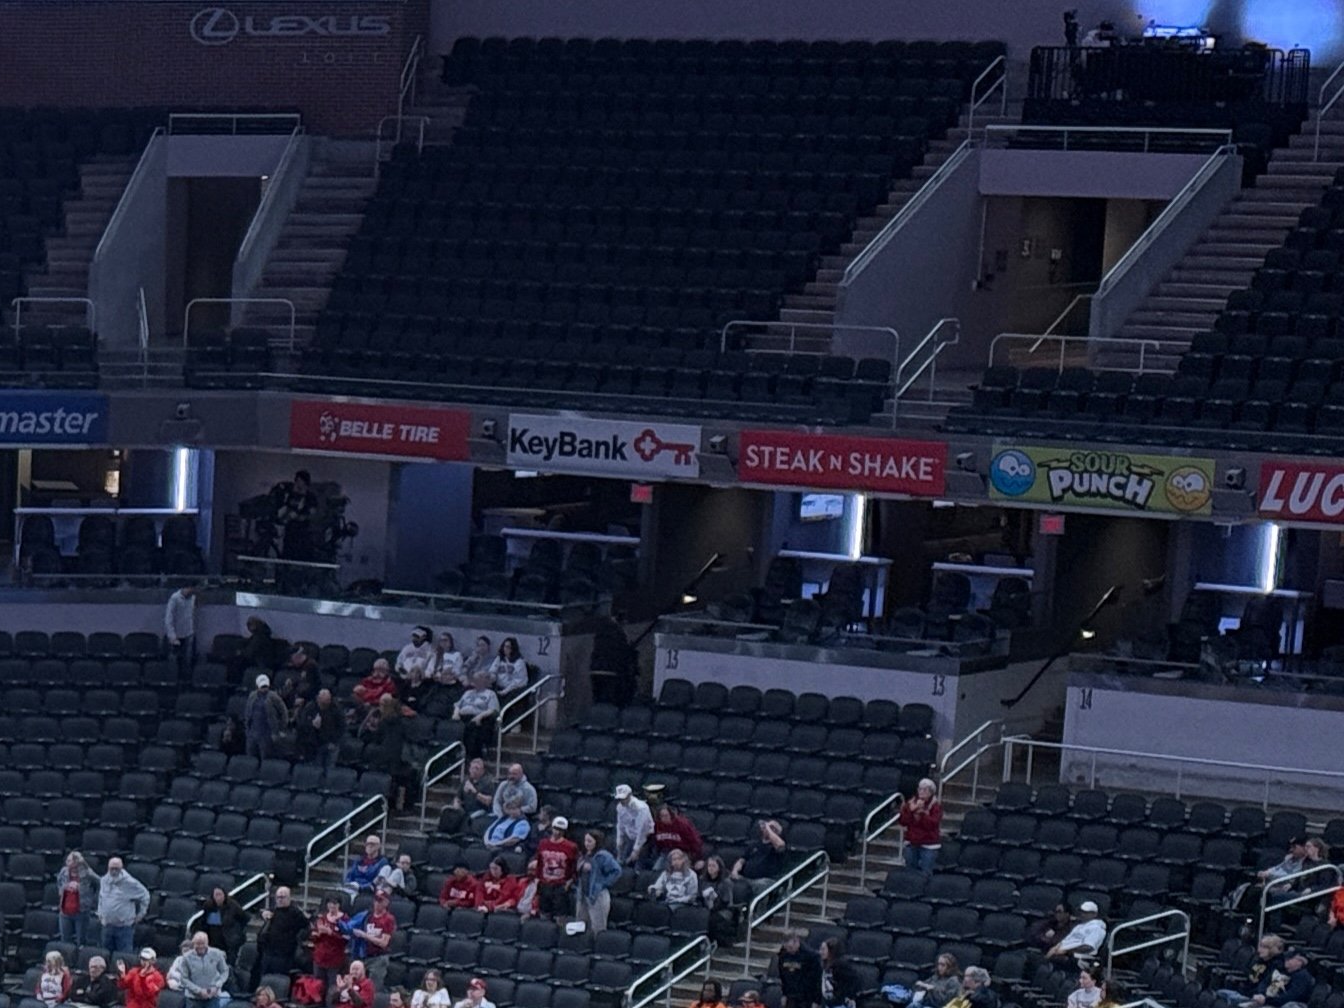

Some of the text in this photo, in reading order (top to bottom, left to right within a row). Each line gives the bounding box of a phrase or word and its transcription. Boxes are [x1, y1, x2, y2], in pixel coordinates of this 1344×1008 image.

[245, 15, 391, 35] LEXUS
[339, 419, 440, 444] BELLE TIRE
[511, 430, 627, 464] KeyBank
[745, 445, 934, 481] STEAK N SHAKE
[1070, 451, 1132, 474] SOUR
[1047, 468, 1155, 507] PUNCH
[537, 636, 551, 656] 12
